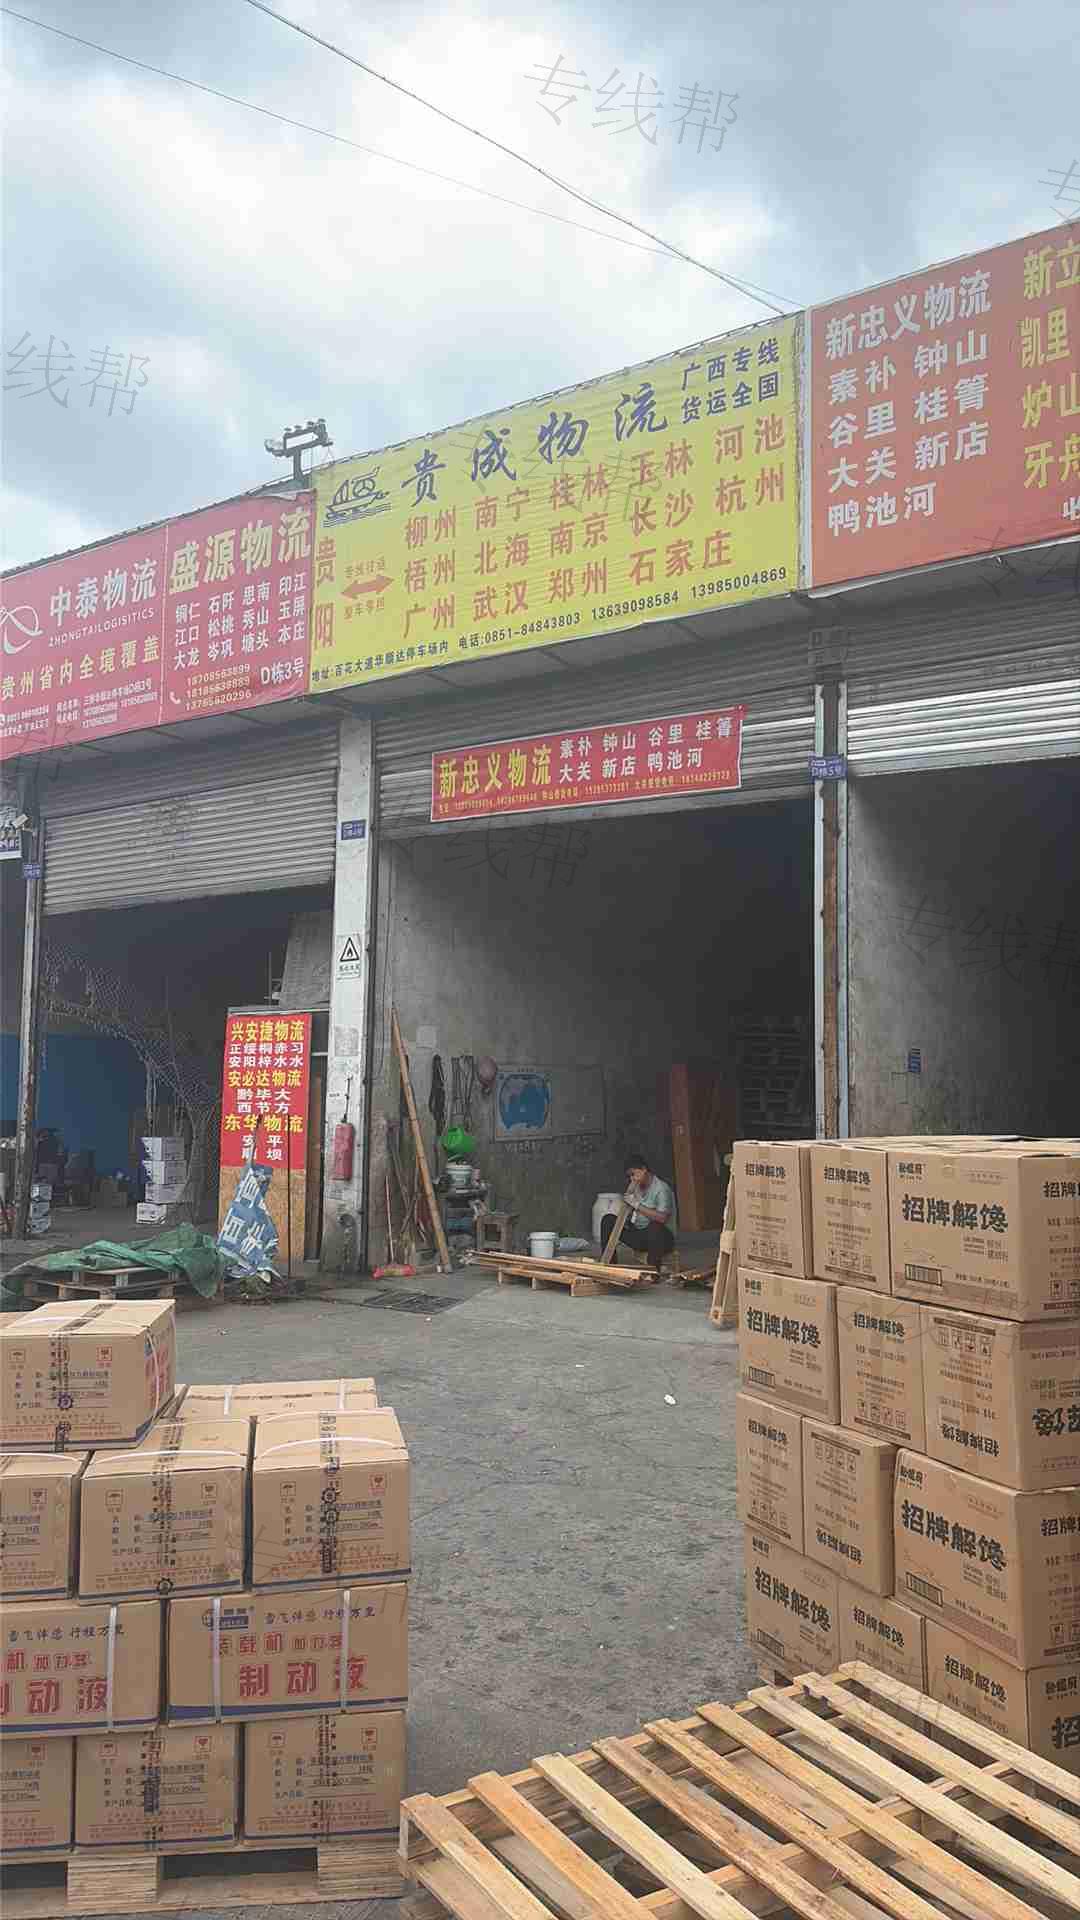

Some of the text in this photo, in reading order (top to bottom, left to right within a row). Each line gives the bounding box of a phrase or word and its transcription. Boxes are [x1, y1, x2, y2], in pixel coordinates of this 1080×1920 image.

[826, 269, 991, 361] 新忠义物流
[1019, 307, 1071, 369] 凯里
[682, 337, 780, 393] 广西专线
[828, 329, 987, 406] 素补 钟山
[681, 370, 779, 426] 货运全国
[827, 400, 896, 449] 谷里
[401, 382, 668, 508] 贵成物流
[828, 421, 989, 494] 大关 新店
[404, 412, 786, 552] 柳州 南宁 桂林 玉林 河池
[828, 480, 936, 537] 鸭池河
[169, 506, 311, 594] 盛源物流
[403, 461, 786, 594] 梧州 北海 南京 长沙 杭州
[49, 557, 157, 627] 中泰物流
[175, 601, 200, 624] 铜仁
[243, 580, 271, 605] 思南
[279, 571, 307, 596] 印江
[403, 528, 733, 640] 广州 武汉 郑州 石家庄
[689, 567, 788, 601] 13985004869
[174, 647, 201, 671] 大龙
[278, 621, 305, 645] 本庄
[175, 596, 305, 647] 江口 松桃 秀山 玉屏
[0, 634, 160, 700] 贵州省内全境覆盖
[260, 656, 305, 685] D栋3号
[559, 747, 703, 784] 大关 新店 鸭池河
[602, 731, 637, 753] 钟山
[648, 723, 684, 748] 谷里
[439, 744, 552, 800] 新忠义物流
[228, 1069, 302, 1088] 安必达物流
[224, 1113, 304, 1133] 东华物流
[901, 1193, 1009, 1234] 招牌解馋
[1042, 1180, 1080, 1199] 招牌
[746, 1306, 821, 1349] 招牌解馋
[901, 1499, 1008, 1573] 招牌解馋
[1041, 1516, 1080, 1538] 招牌
[754, 1566, 833, 1633] 招牌解馋
[239, 1654, 369, 1698] 制动液
[944, 1654, 1008, 1704] 招牌解馋
